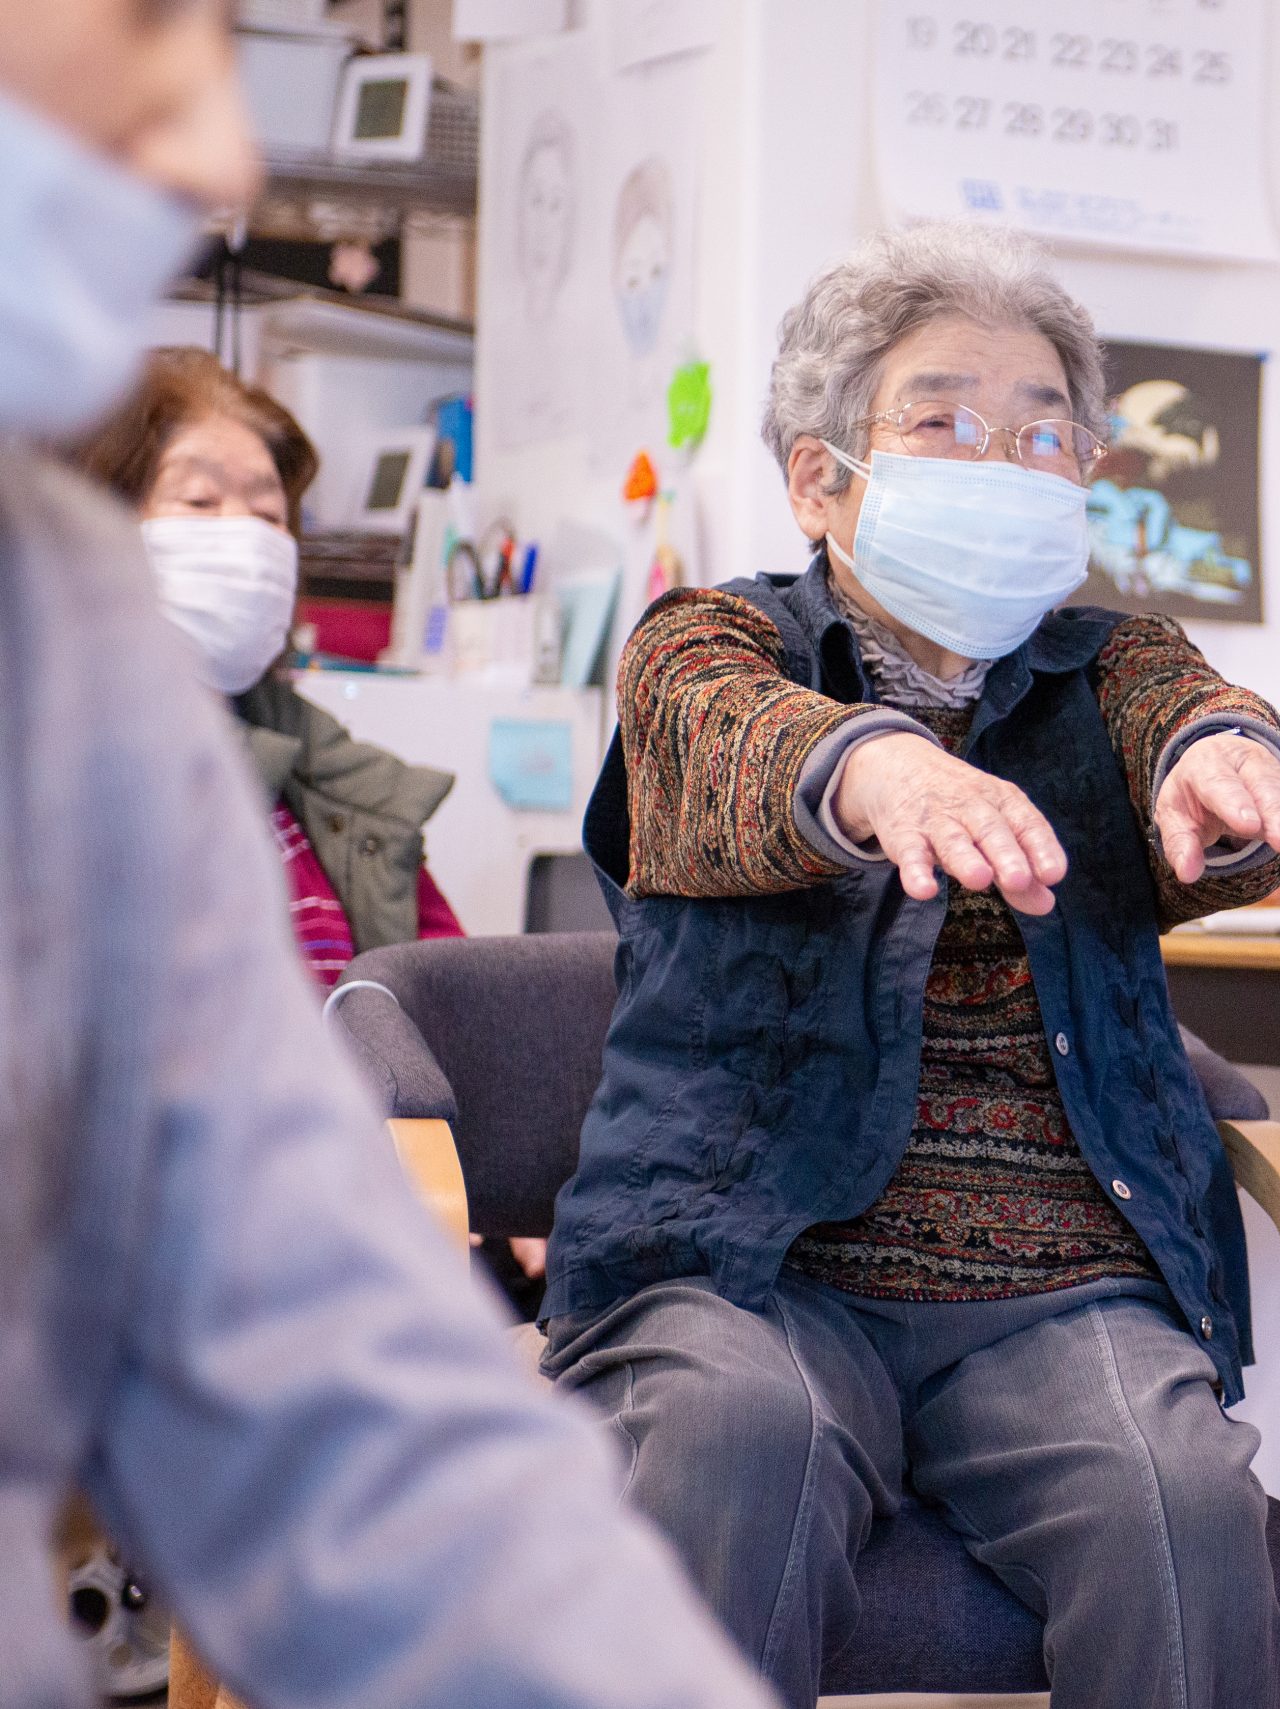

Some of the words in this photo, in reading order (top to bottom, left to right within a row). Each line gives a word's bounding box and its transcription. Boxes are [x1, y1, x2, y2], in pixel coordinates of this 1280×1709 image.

[953, 19, 997, 57] 20
[1002, 26, 1038, 62] 21
[1050, 32, 1093, 70] 22
[1098, 37, 1140, 75] 23
[1145, 43, 1184, 80] 24
[1191, 49, 1234, 86] 25
[953, 95, 993, 132] 27
[1002, 100, 1045, 138] 28
[1051, 106, 1095, 144] 29
[1099, 112, 1143, 148] 30
[1145, 117, 1180, 153] 31
